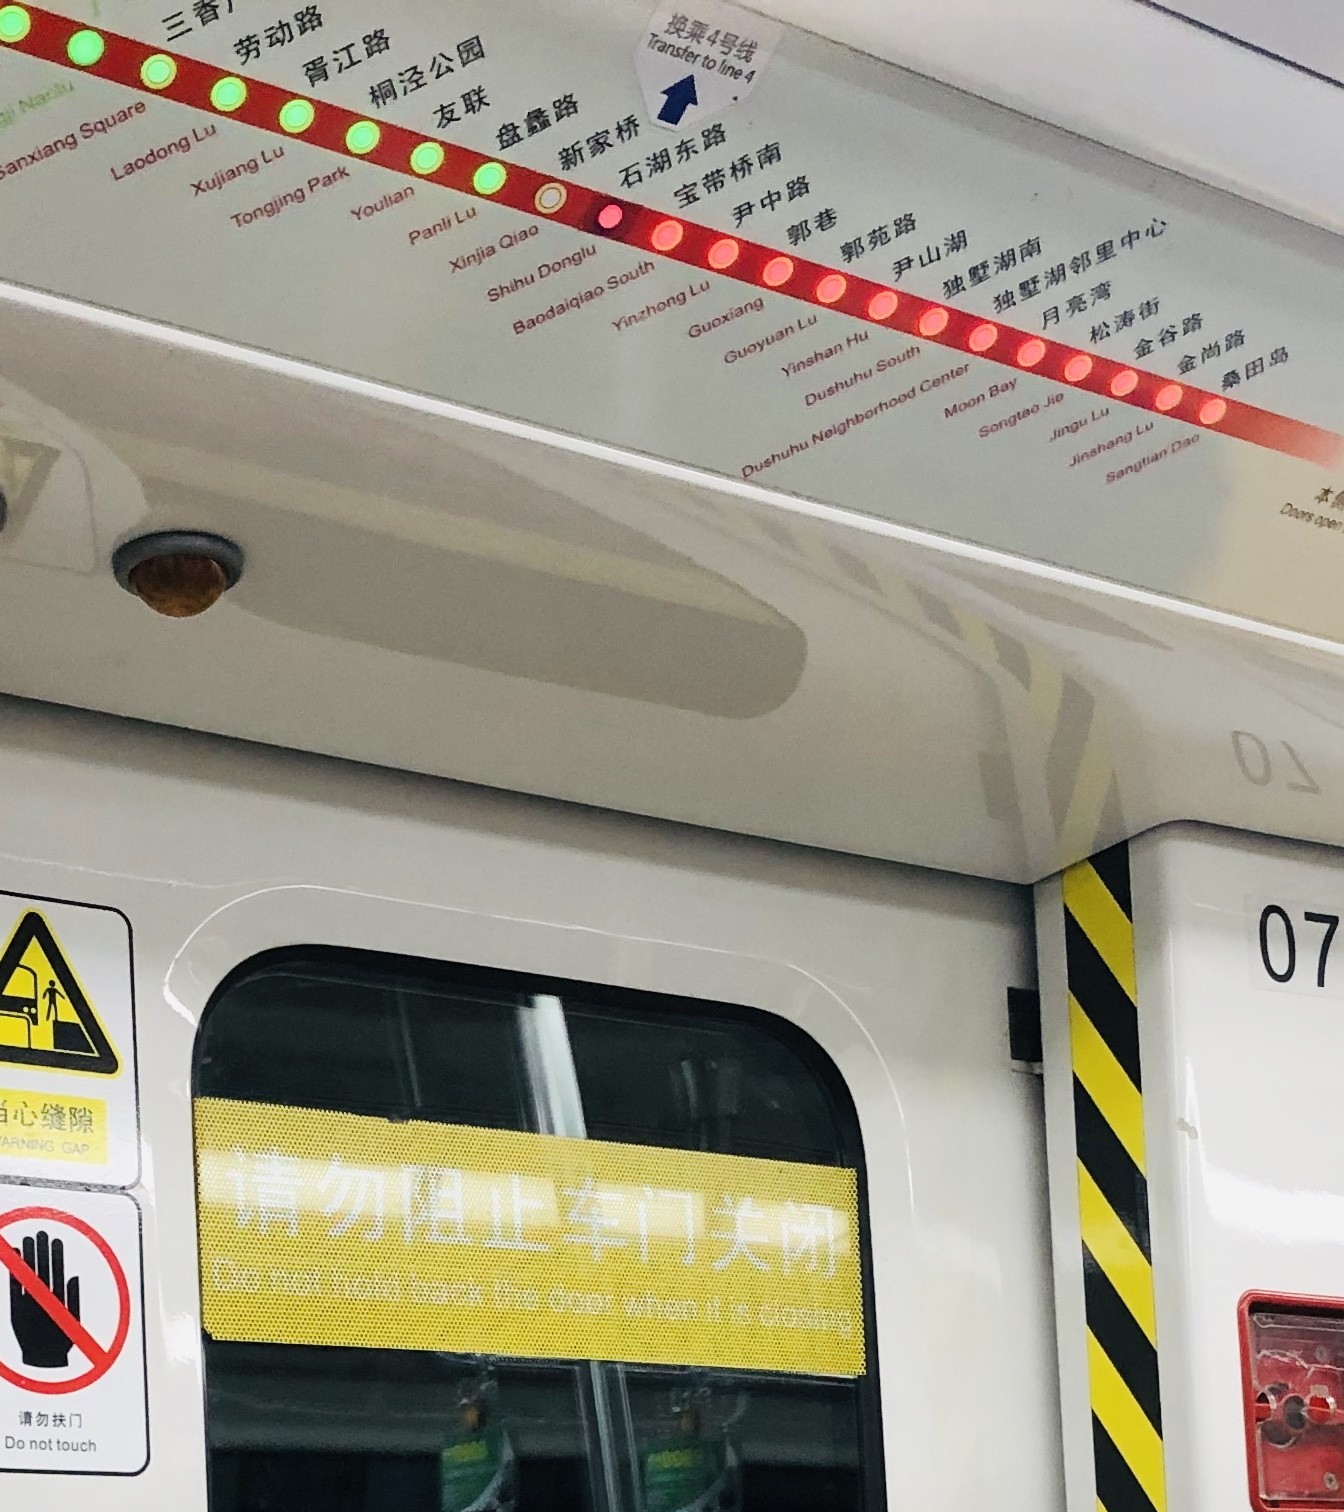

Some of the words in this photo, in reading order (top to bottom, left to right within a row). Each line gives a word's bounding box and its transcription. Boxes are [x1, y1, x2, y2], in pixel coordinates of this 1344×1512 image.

[161, 0, 233, 42] 三香
[233, 3, 325, 66] 劳动路
[663, 12, 758, 64] 换乘4号线
[302, 28, 391, 88] 胥江路
[368, 34, 485, 109] 桐泾公园
[646, 32, 702, 67] Transfer
[702, 52, 718, 72] to
[719, 58, 743, 81] line
[744, 69, 756, 85] 4
[79, 100, 147, 141] Square
[432, 84, 490, 129] 友联
[495, 92, 580, 151] 盘蠡路
[110, 133, 191, 182] Laodong
[192, 122, 218, 144] Lu
[557, 113, 641, 172] 新家桥
[618, 121, 728, 189] 石湖东路
[190, 156, 260, 198] Xujiang
[261, 144, 285, 165] Lu
[230, 185, 306, 229] Tongjing
[307, 164, 350, 194] Park
[673, 140, 783, 209] 宝带桥南
[350, 185, 415, 222] Youlian
[408, 216, 453, 246] Panli
[454, 204, 478, 225] Lu
[731, 174, 811, 228] 尹中路
[786, 207, 838, 247] 郭巷
[448, 242, 496, 274] Xinjia
[498, 223, 540, 251] Qiao
[839, 212, 917, 264] 郭苑路
[892, 229, 969, 282] 尹山湖
[487, 272, 536, 303] Shihu
[537, 243, 597, 280] Donglu
[942, 235, 1042, 300] 独墅湖南
[992, 217, 1168, 314] 独墅湖邻里中心
[512, 284, 605, 336] Baodaiqiao
[606, 259, 656, 291] South
[611, 290, 687, 333] Yinzhong
[688, 279, 711, 297] Lu
[688, 296, 764, 340] Guoxiang
[1041, 280, 1112, 331] 月亮湾
[1089, 296, 1160, 344] 松涛街
[723, 324, 796, 365] Guoyuan
[796, 313, 818, 334] Lu
[780, 342, 844, 378] Yinshan
[845, 329, 869, 349] Hu
[1132, 311, 1203, 360] 金谷路
[1176, 328, 1246, 376] 金尚路
[804, 367, 874, 407] Dushuhu
[875, 344, 921, 374] South
[1220, 346, 1290, 391] 桑田岛
[741, 440, 810, 480] Dushuhu
[811, 385, 917, 445] Neighborhood
[919, 362, 971, 392] Center
[944, 391, 986, 419] Moon
[988, 377, 1018, 400] Bay
[978, 403, 1040, 439] Songtao
[1043, 391, 1065, 409] Jie
[1048, 416, 1088, 443] Jingu
[1091, 406, 1110, 423] Lu
[1068, 427, 1134, 468] Jinshang
[1134, 420, 1154, 438] Lu
[1105, 446, 1167, 484] Sangtian
[1168, 432, 1200, 455] Dao
[1259, 904, 1340, 988] 07
[62, 1141, 91, 1155] GAP
[226, 1145, 838, 1279] 请勿阻止车门关闭
[4, 1435, 27, 1451] Do
[30, 1437, 55, 1452] not
[56, 1437, 97, 1454] touch
[18, 1410, 84, 1429] 请勿扶门
